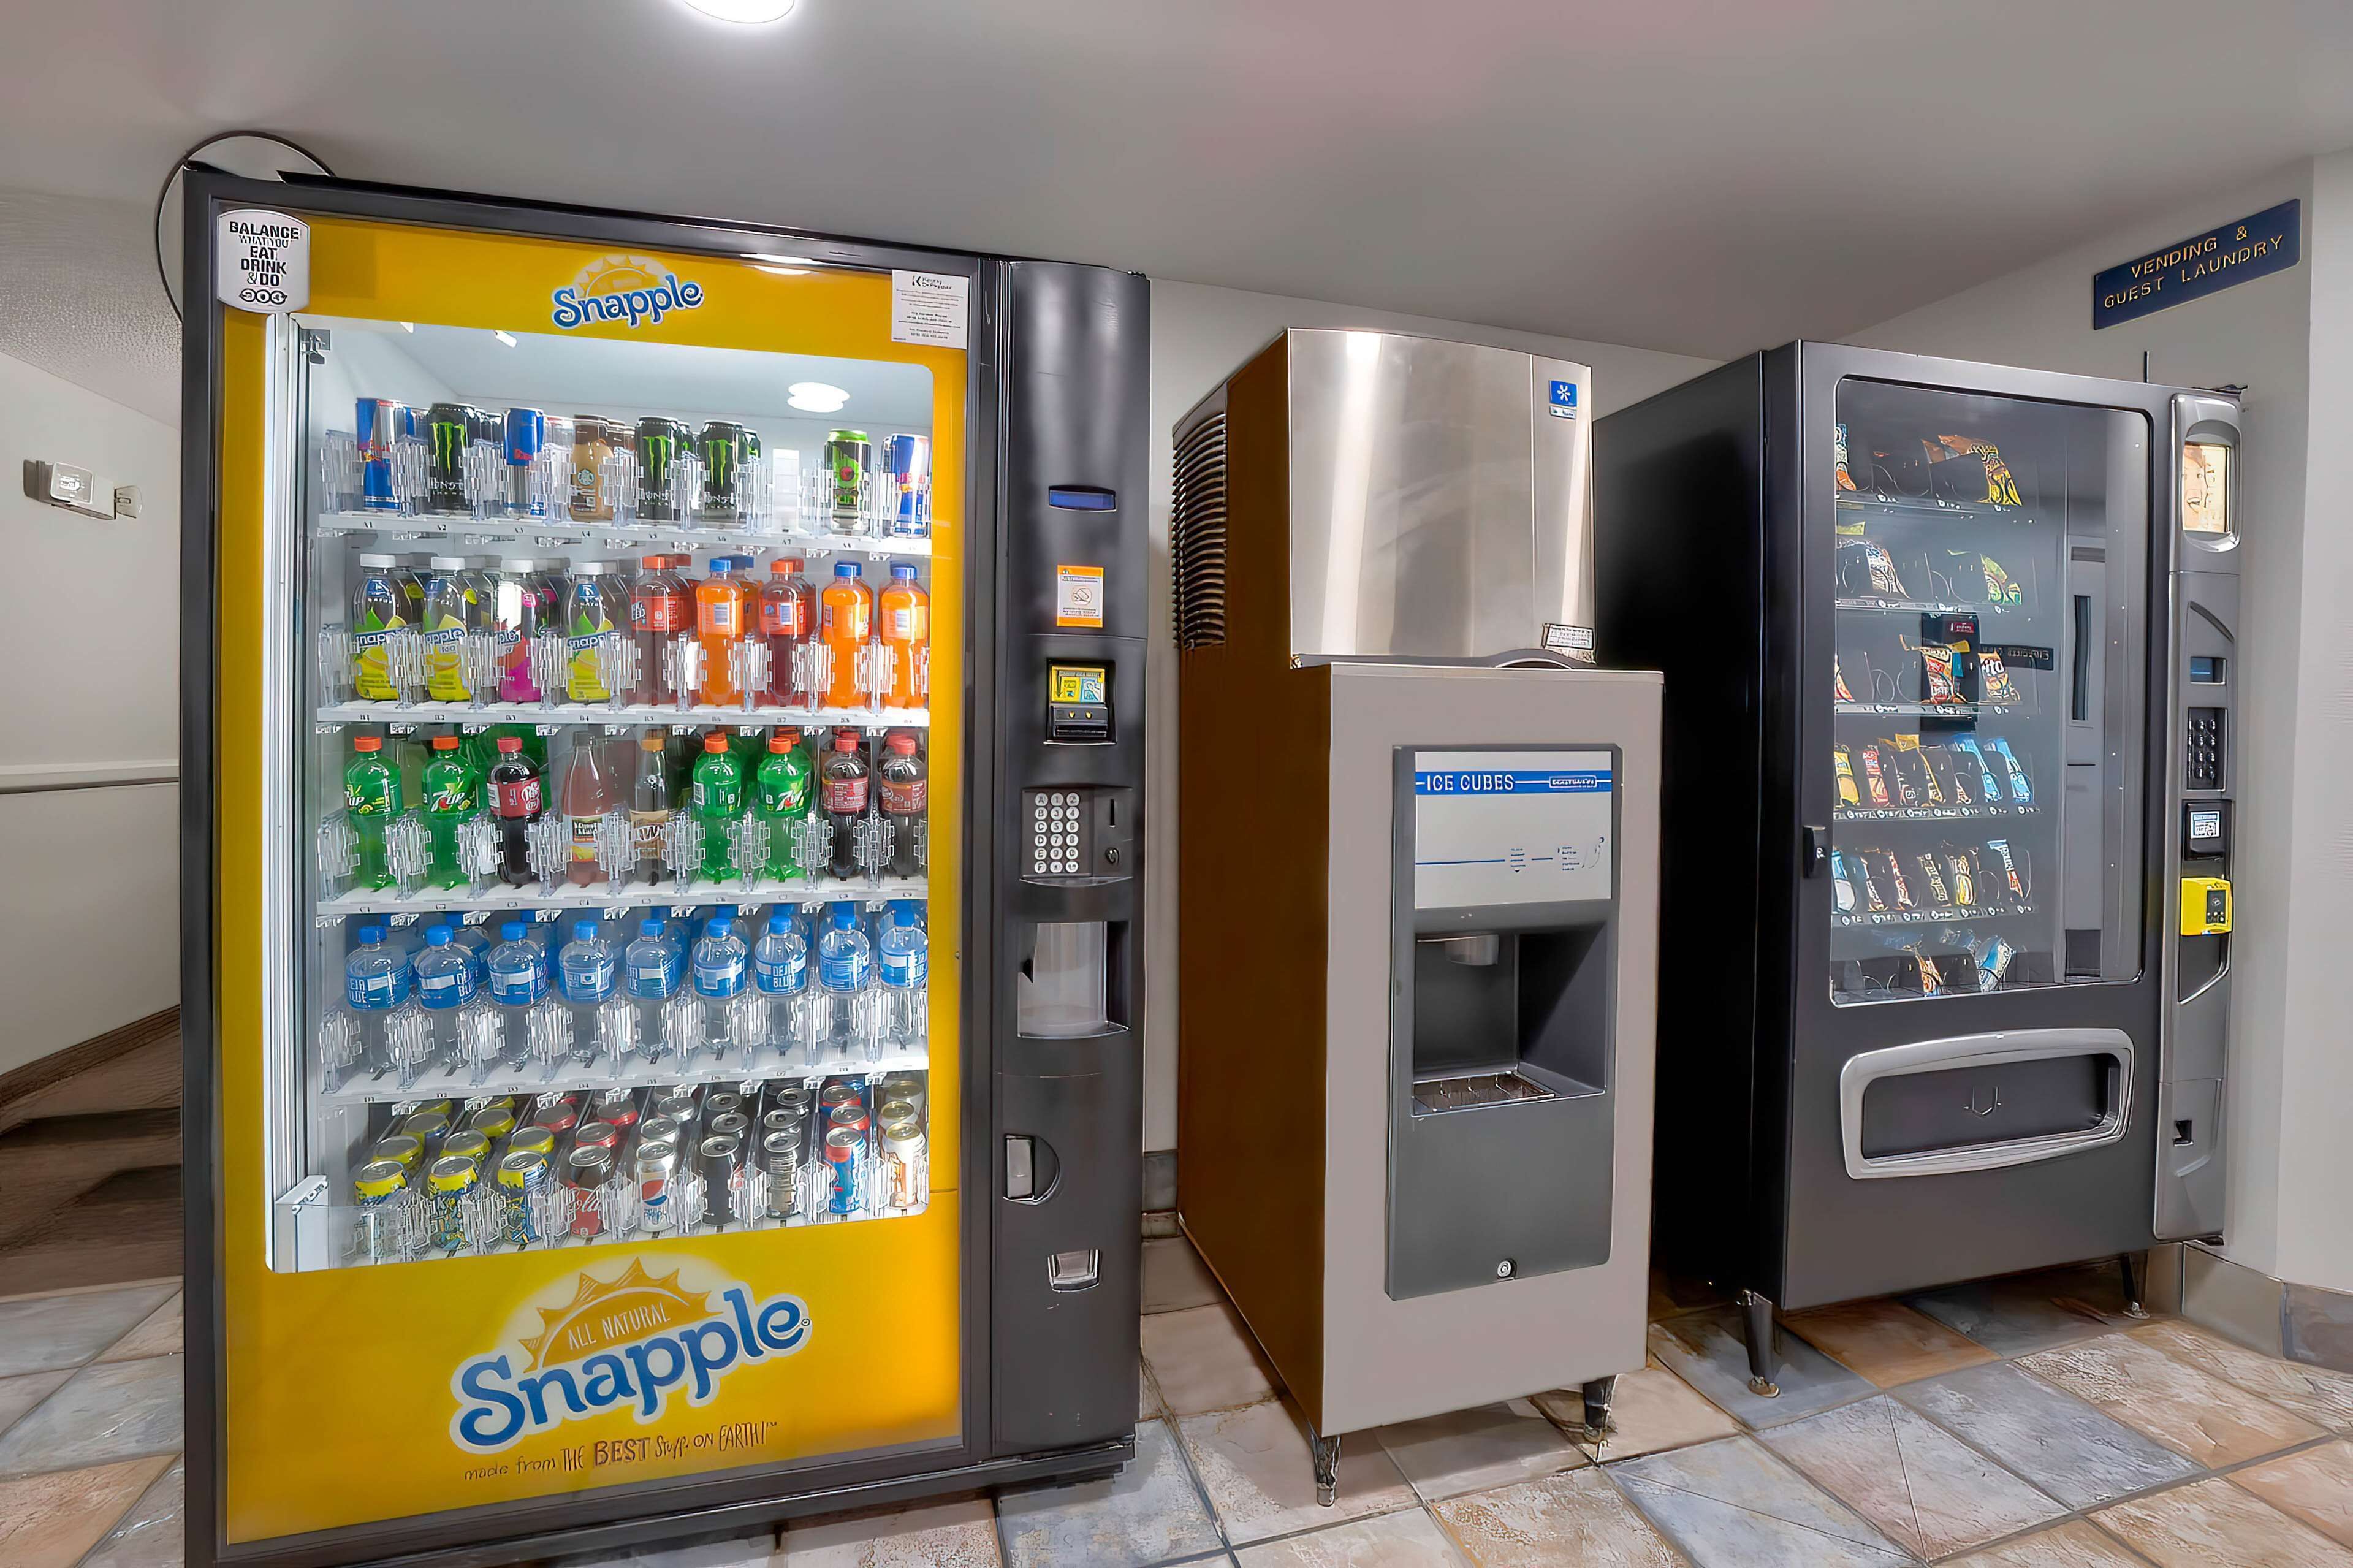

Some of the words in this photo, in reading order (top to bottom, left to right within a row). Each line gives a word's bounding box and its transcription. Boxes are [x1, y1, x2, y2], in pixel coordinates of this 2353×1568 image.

[230, 221, 300, 240] BALANCE
[2131, 237, 2218, 278] VENDING
[2235, 225, 2248, 242] &
[241, 259, 287, 275] DRINK
[2104, 276, 2165, 309] GUEST
[2181, 234, 2284, 283] LAUNDRY
[247, 272, 258, 284] &
[260, 273, 280, 287] DO
[553, 274, 702, 328] Snapple
[1427, 775, 1453, 791] ICE
[1461, 774, 1515, 790] CUBES
[1038, 823, 1044, 831] C
[1038, 835, 1044, 844] D
[1054, 835, 1059, 844] 7
[1038, 863, 1044, 872] F
[568, 1323, 597, 1350] ALL
[602, 1302, 671, 1340] NATURAL
[460, 1288, 803, 1445] Snapple
[465, 1462, 509, 1481] made
[516, 1456, 557, 1474] from
[560, 1445, 586, 1472] THE
[594, 1437, 651, 1466] BEST
[693, 1432, 713, 1448] ON
